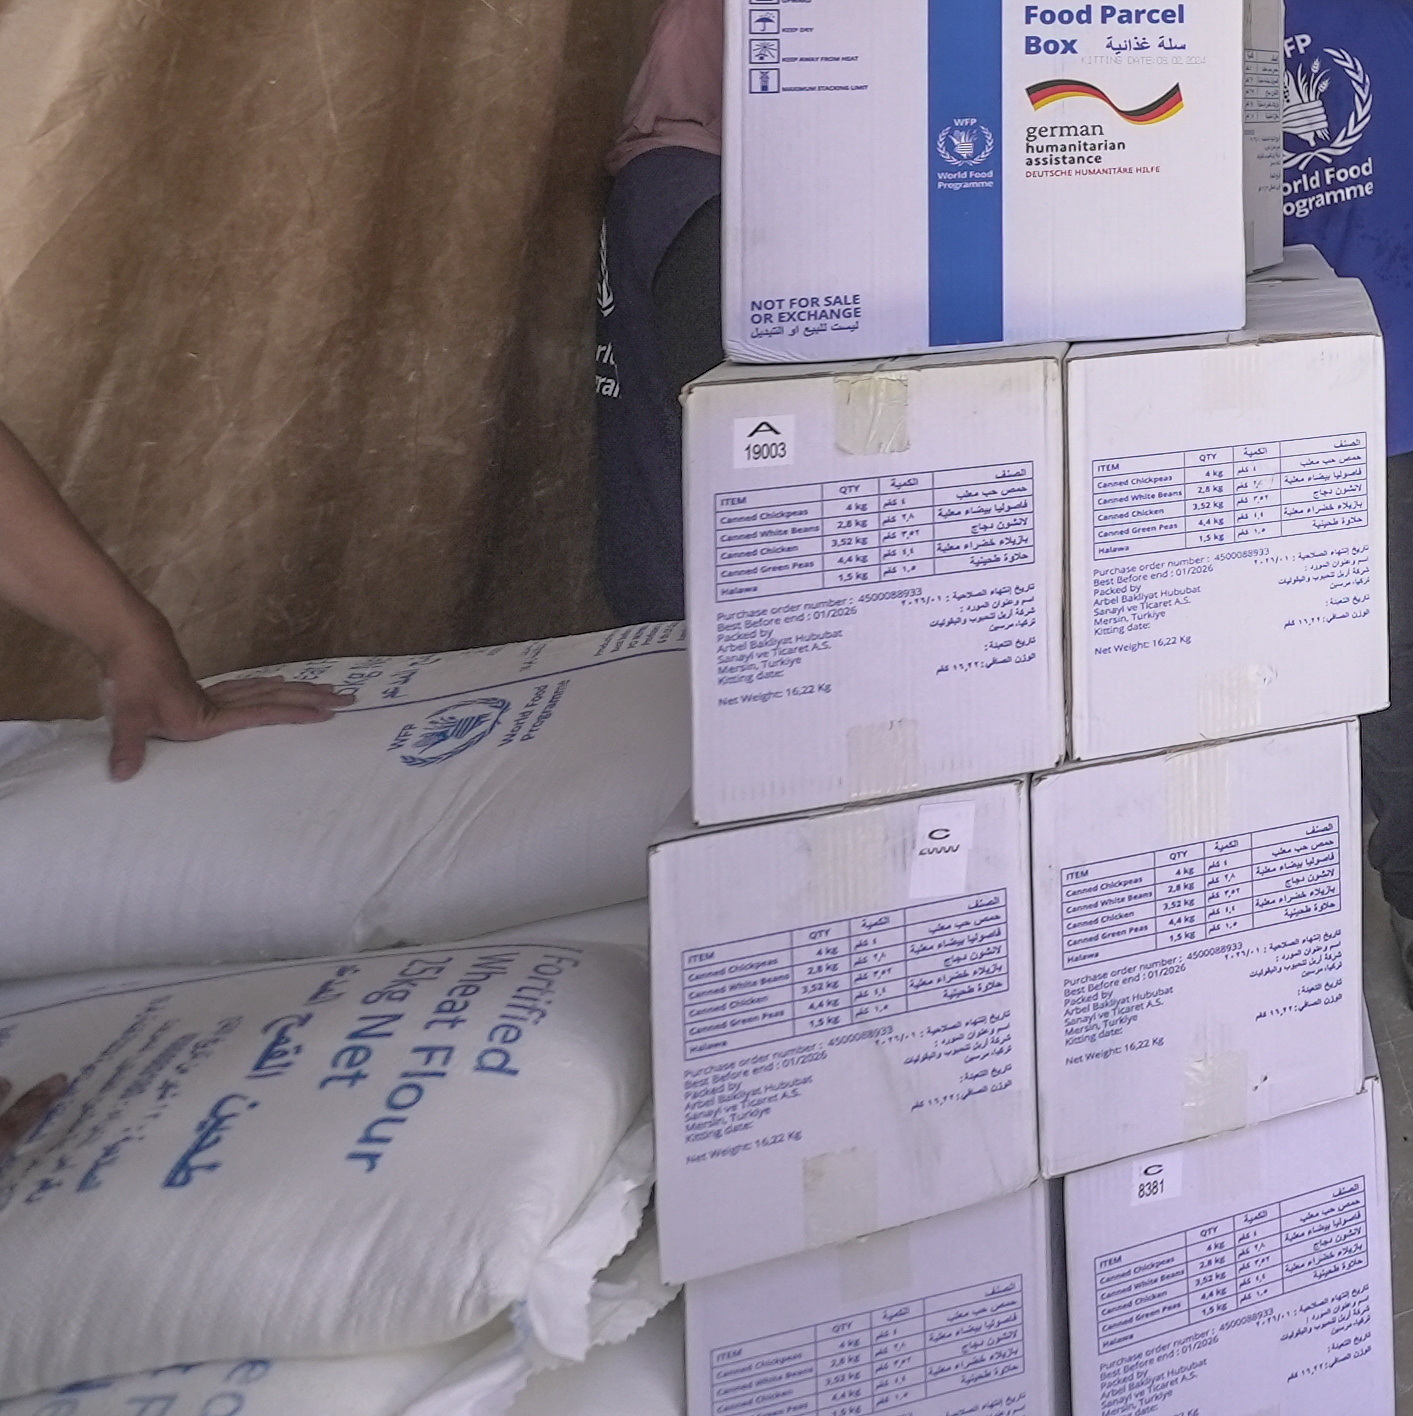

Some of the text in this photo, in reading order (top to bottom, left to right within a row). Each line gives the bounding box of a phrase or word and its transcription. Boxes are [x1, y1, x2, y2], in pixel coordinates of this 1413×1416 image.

[1025, 4, 1184, 24] Food Parcel
[1025, 36, 1078, 54] Box
[1284, 34, 1312, 58] FP
[1081, 56, 1122, 64] KITTING
[953, 118, 977, 126] WFP
[1026, 124, 1104, 142] german
[1026, 140, 1125, 153] humanitarian
[1025, 154, 1102, 166] assistance
[937, 170, 993, 179] World Food
[1026, 170, 1072, 178] DEUTSCHE
[1283, 157, 1373, 196] orld Food
[937, 181, 994, 190] Programme
[1283, 181, 1374, 218] ogramme
[751, 294, 860, 311] NOT FOR SALE
[751, 307, 861, 324] OR EXCHANGE
[747, 422, 782, 437] A
[745, 442, 786, 460] 19003
[1199, 454, 1217, 462] QTY
[1098, 464, 1120, 472] ITEM
[1097, 480, 1128, 489] Canned
[1131, 476, 1172, 484] Chickpeas
[1098, 496, 1128, 505] Canned
[1213, 485, 1223, 493] kg
[1098, 513, 1129, 521] Canned
[1132, 509, 1164, 517] Chicken
[1098, 529, 1129, 537] Canned
[1093, 566, 1136, 576] Purchase
[1139, 562, 1164, 571] order
[1093, 578, 1114, 587] Best
[1117, 573, 1147, 584] Before
[1176, 564, 1213, 576] 01/2026
[1093, 584, 1141, 596] Packed by
[1093, 597, 1118, 606] Arbel
[1160, 586, 1201, 596] Hububat
[1094, 607, 1125, 616] Sanayi
[1140, 600, 1172, 610] Ticaret
[1094, 623, 1150, 636] Kitting date:
[1095, 635, 1191, 655] Net Weight: 16,22 Kg
[497, 684, 549, 748] World Food
[520, 680, 570, 742] Programme
[387, 724, 417, 751] WFP
[929, 829, 951, 840] C
[318, 956, 453, 1089] 25kg Net
[474, 955, 580, 1076] Fortified
[346, 952, 520, 1173] Wheat Flour
[1144, 1165, 1163, 1175] C
[1138, 1178, 1164, 1198] 8381
